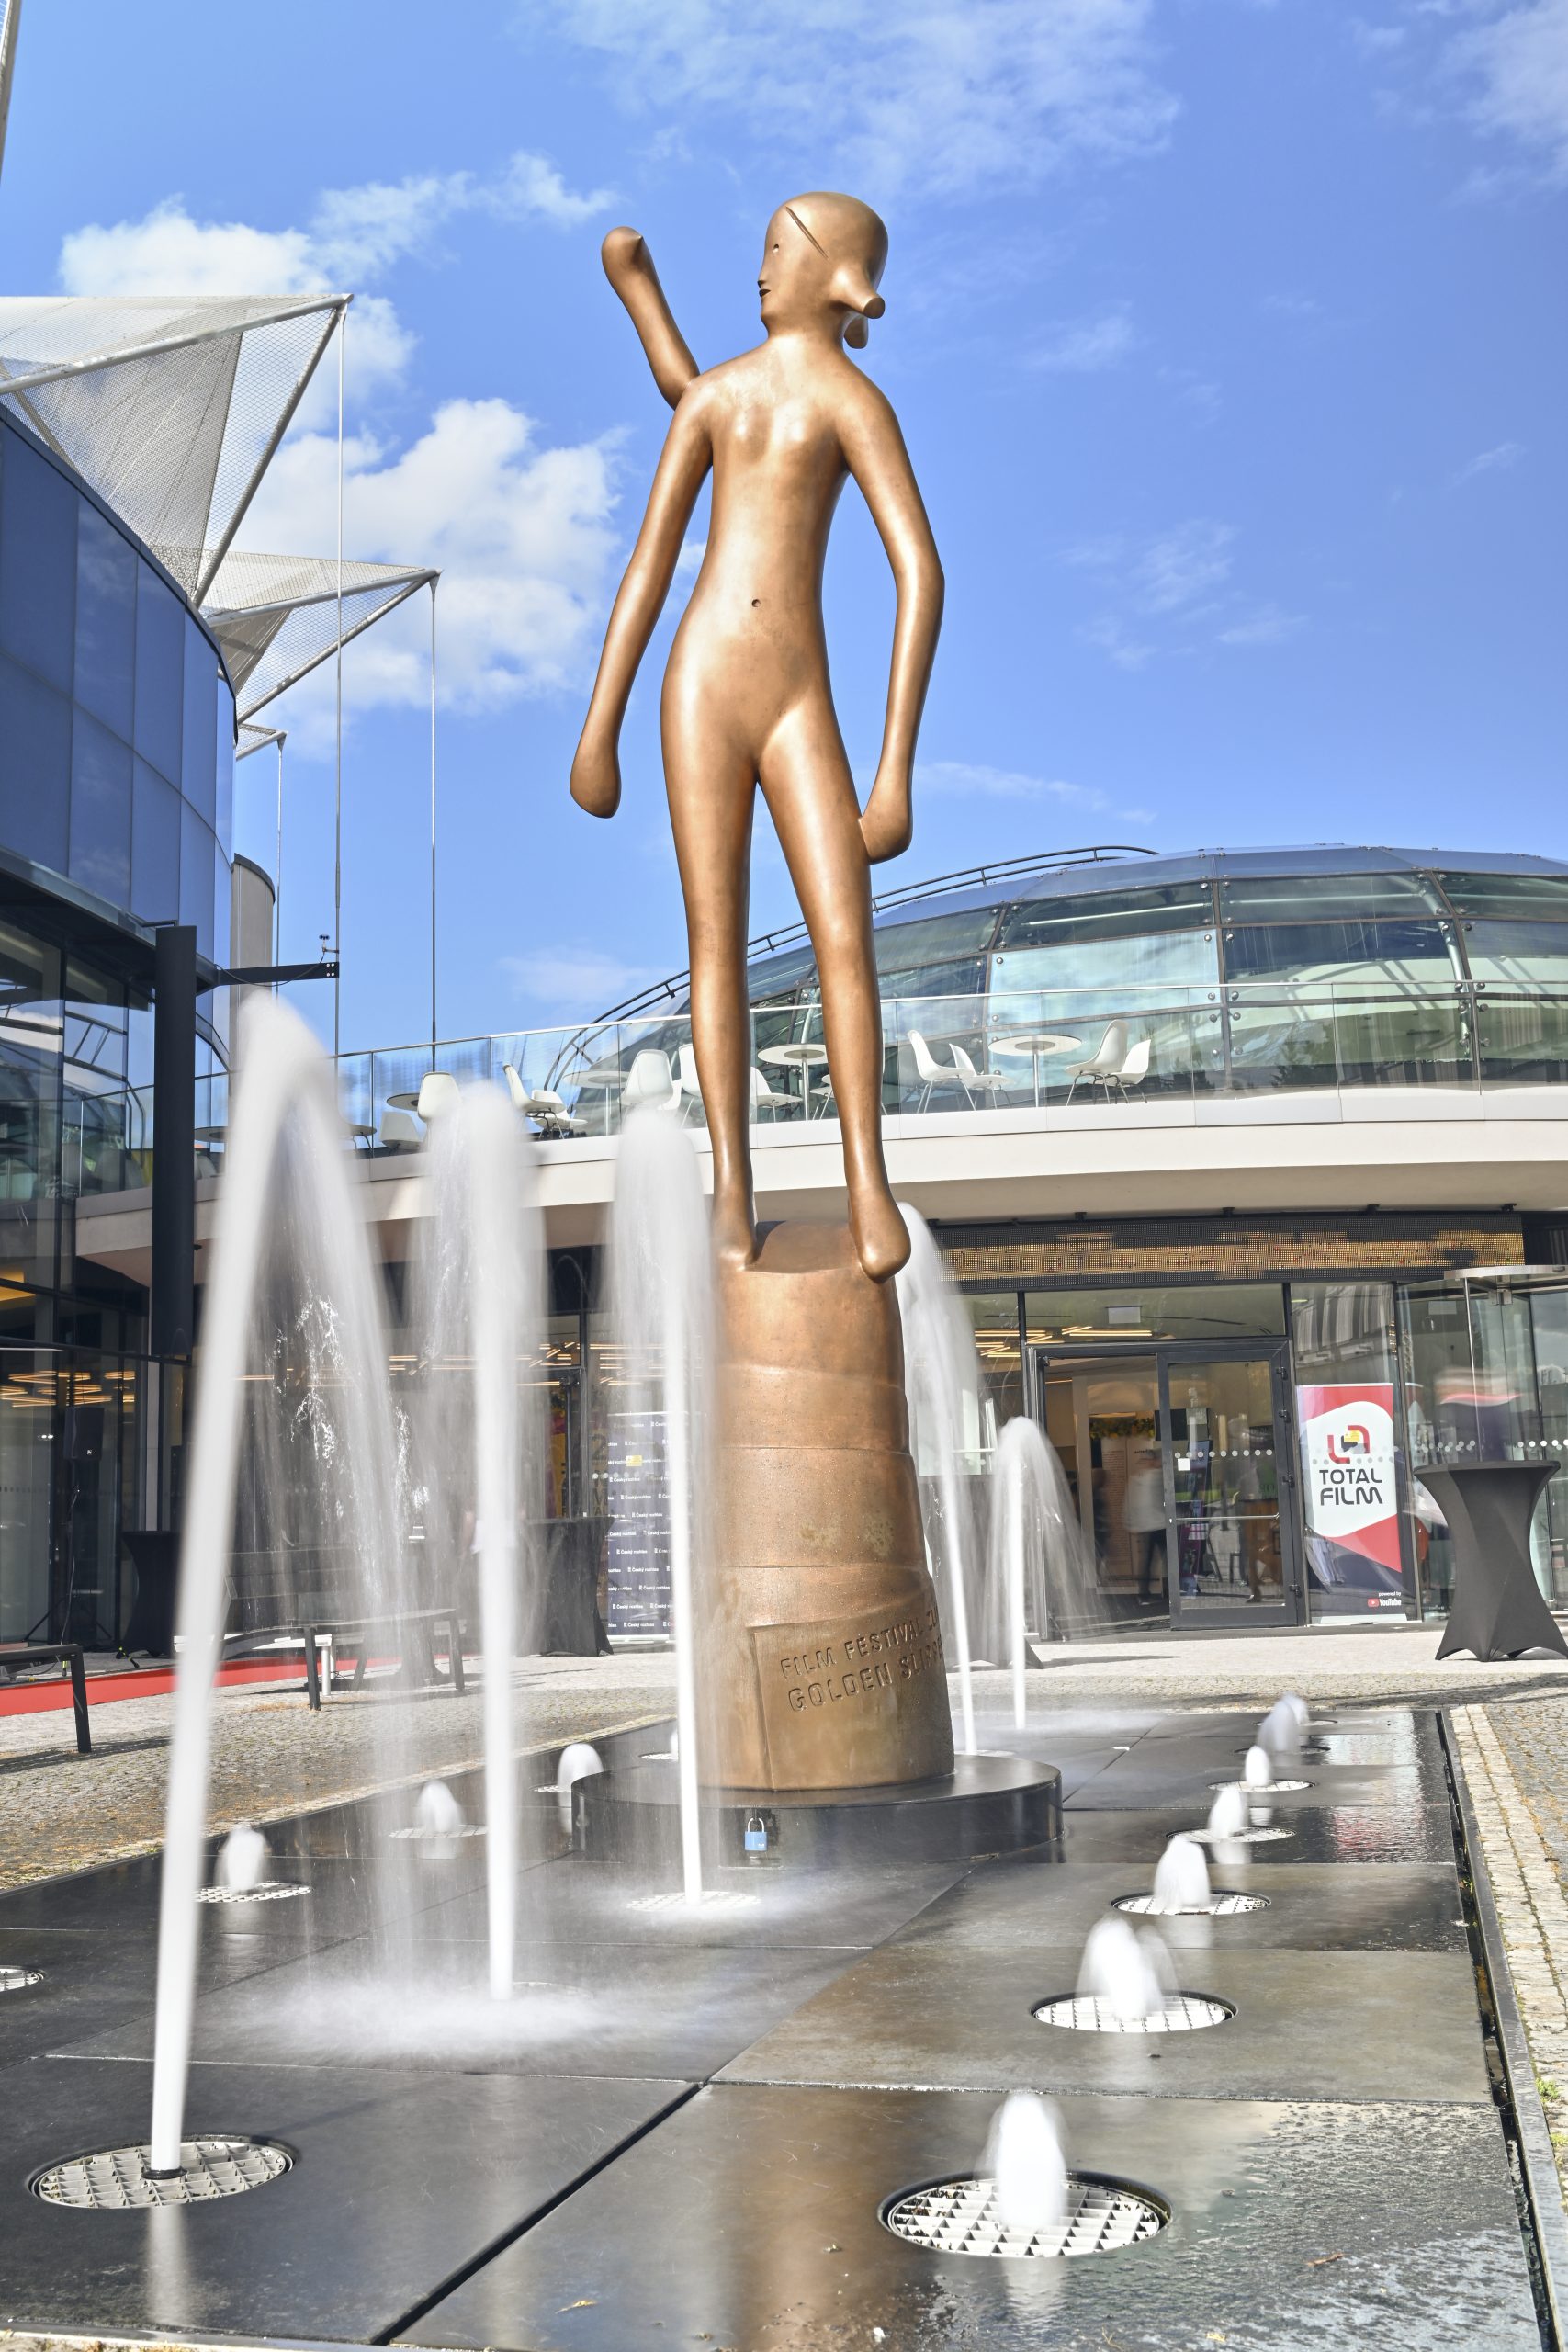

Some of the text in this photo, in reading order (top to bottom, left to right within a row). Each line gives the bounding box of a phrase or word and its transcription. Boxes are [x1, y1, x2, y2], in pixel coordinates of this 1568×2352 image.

[1319, 1468, 1382, 1485] TOTAL
[1320, 1487, 1383, 1506] FILM
[1379, 1598, 1402, 1607] YouTube
[780, 1646, 837, 1679] FILM
[843, 1617, 924, 1662] FESTIVAL
[787, 1662, 894, 1712] GOLDEN
